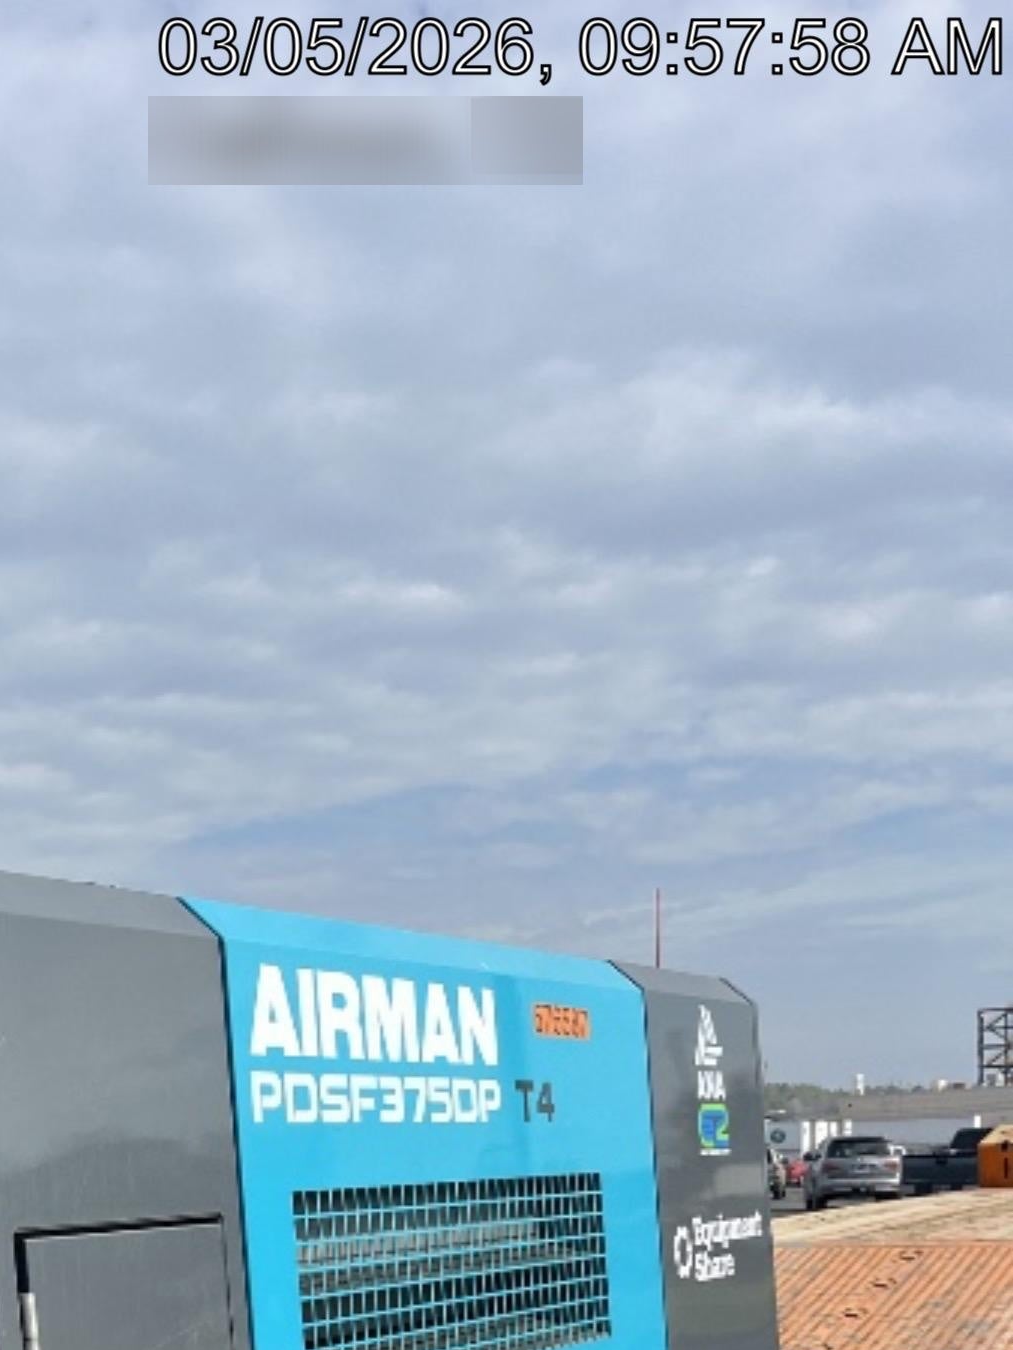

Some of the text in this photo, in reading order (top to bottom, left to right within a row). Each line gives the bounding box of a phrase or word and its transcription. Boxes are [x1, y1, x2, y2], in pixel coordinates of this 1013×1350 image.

[250, 963, 498, 1066] AIRMAN
[514, 1080, 555, 1122] T4
[692, 1211, 763, 1250] Equipment
[694, 1252, 735, 1282] Share
